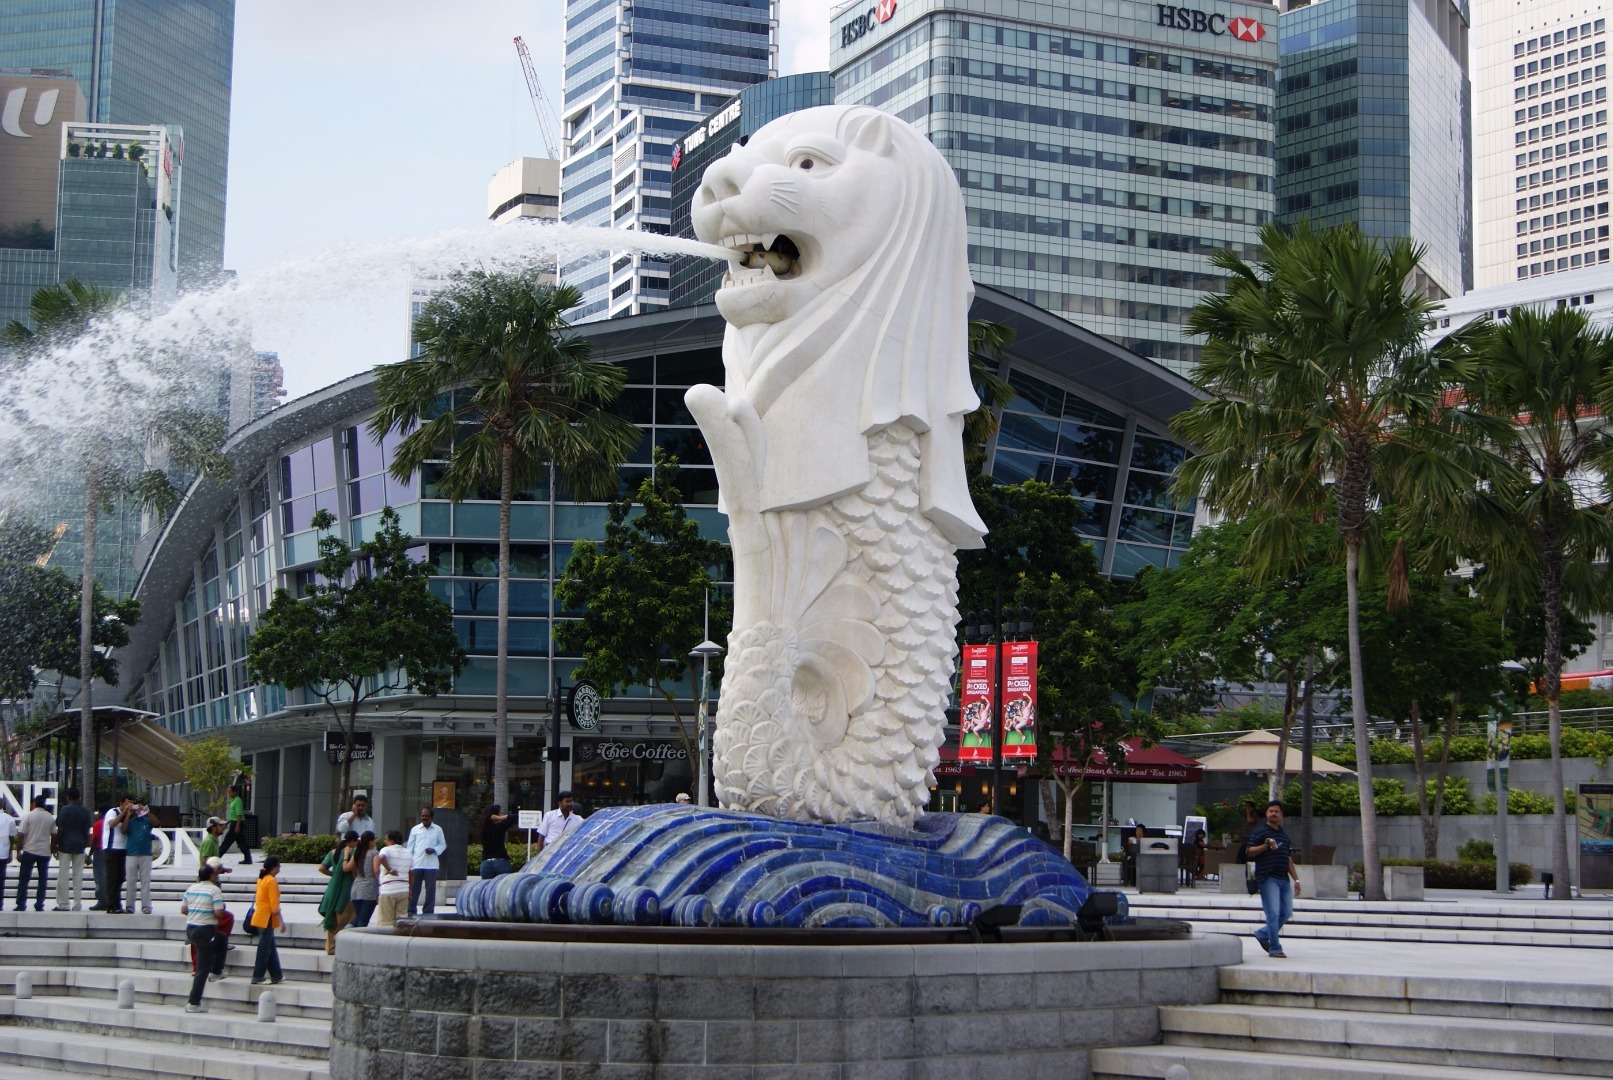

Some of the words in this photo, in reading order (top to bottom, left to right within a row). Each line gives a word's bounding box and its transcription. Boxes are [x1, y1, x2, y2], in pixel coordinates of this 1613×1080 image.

[841, 6, 876, 48] HSBC
[1157, 4, 1225, 36] HSBC
[684, 127, 706, 155] TUNG
[708, 99, 742, 137] CENTRE
[577, 715, 596, 728] COFFEE
[597, 742, 630, 760] The
[632, 743, 687, 760] Coffee
[1106, 767, 1113, 775] &
[1128, 768, 1148, 776] Leaf
